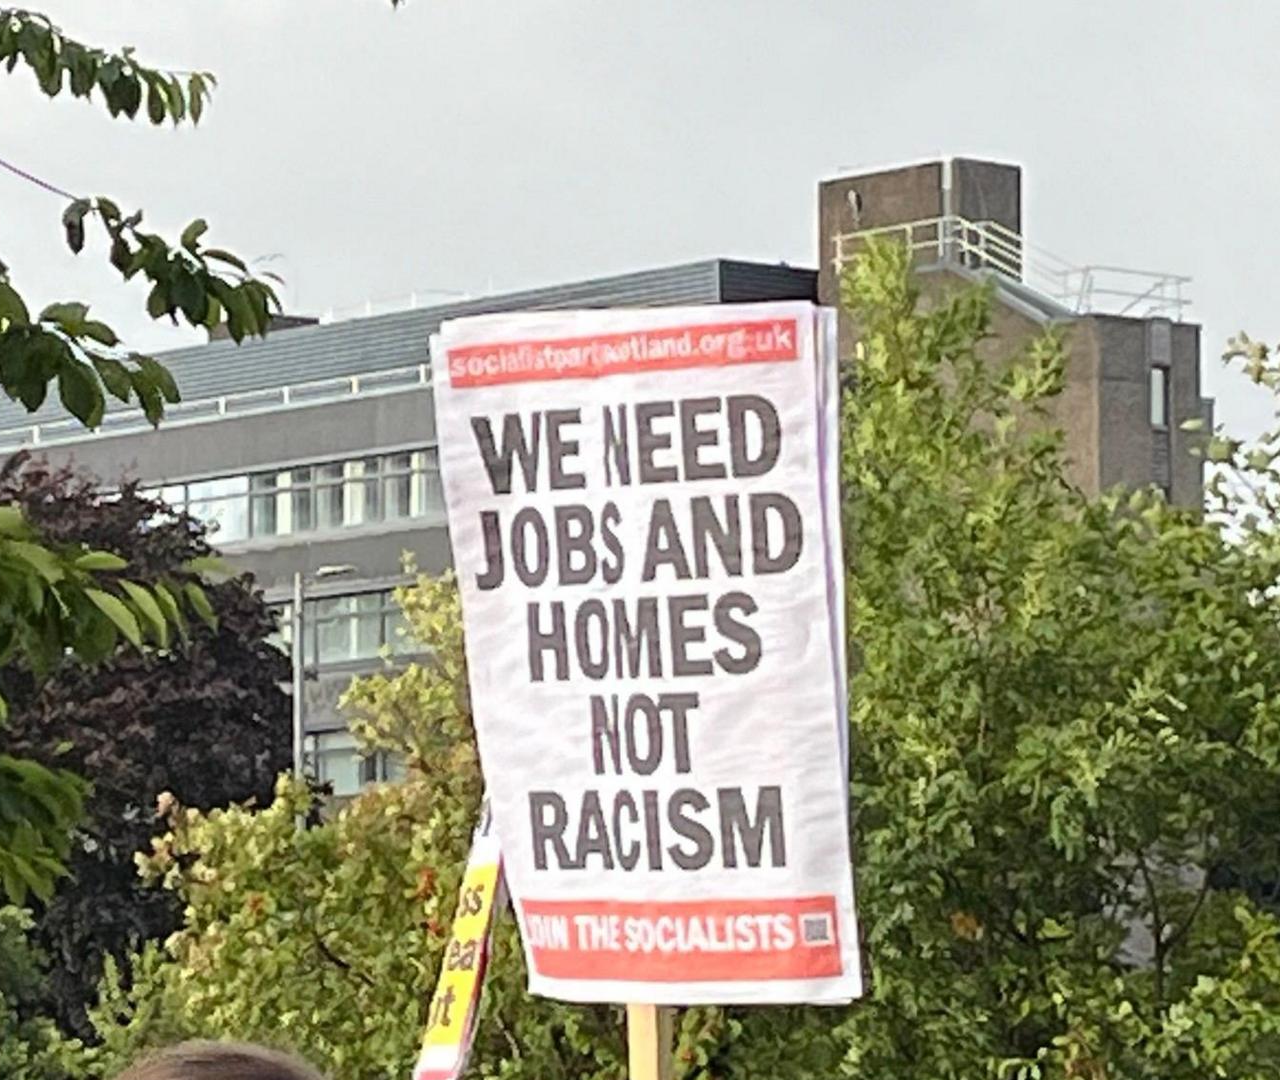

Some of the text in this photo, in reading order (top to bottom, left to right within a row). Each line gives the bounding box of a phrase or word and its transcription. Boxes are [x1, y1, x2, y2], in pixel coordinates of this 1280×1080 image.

[471, 394, 781, 494] WE NEED
[475, 492, 803, 591] JOBS AND
[528, 591, 763, 682] HOMES
[590, 693, 699, 776] NOT
[528, 785, 787, 872] RACISM
[573, 914, 620, 950] THE
[624, 914, 795, 953] SOCIALISTS
